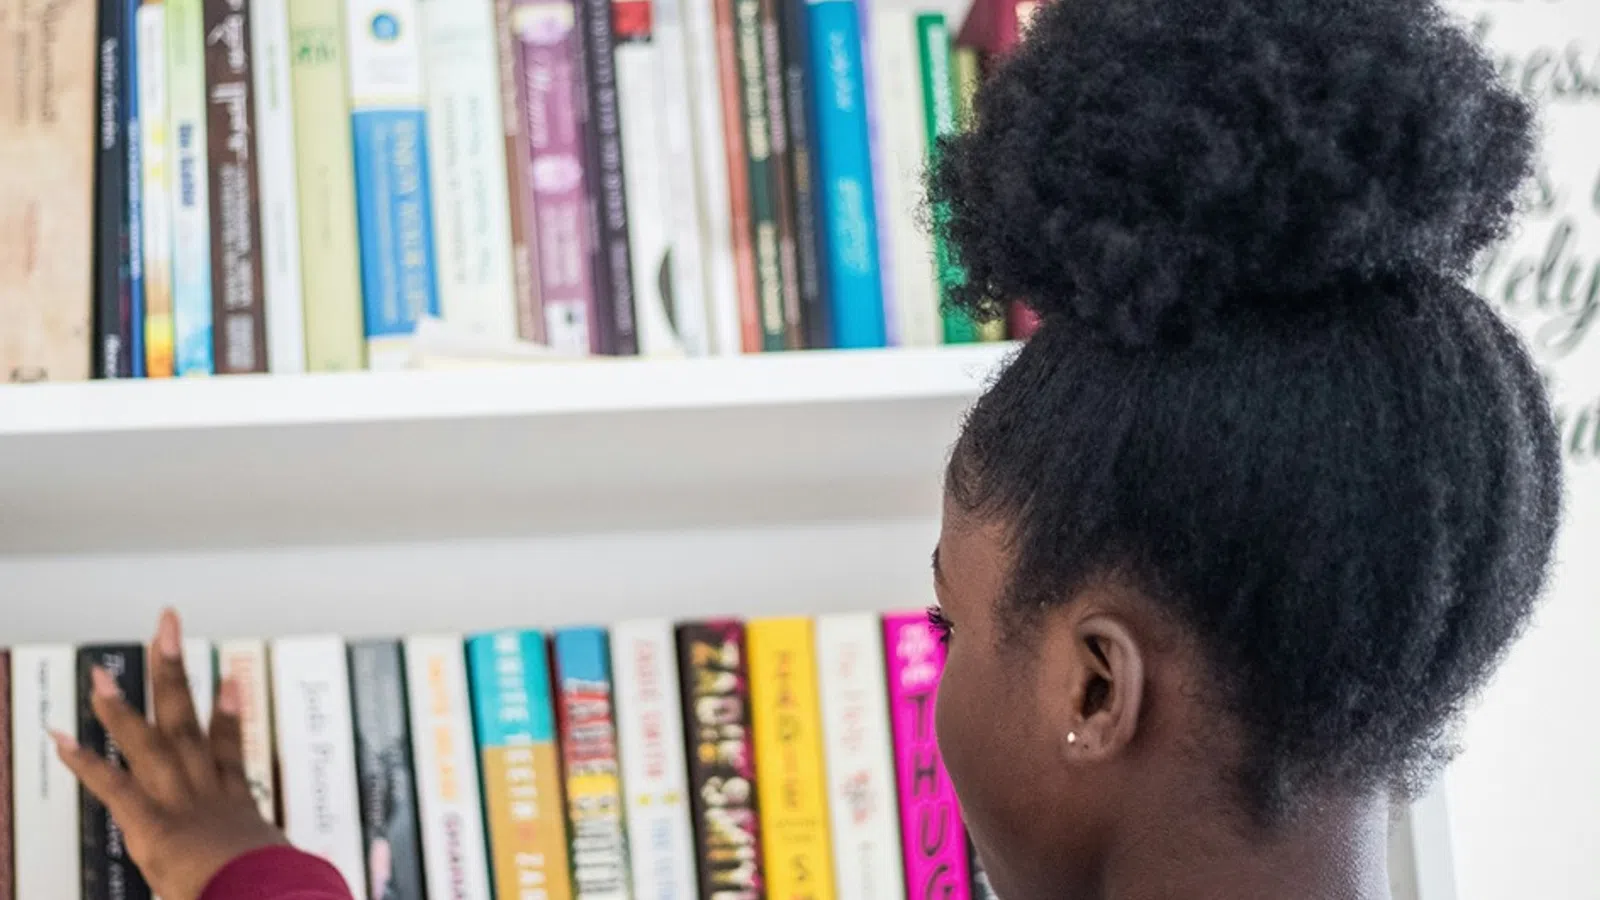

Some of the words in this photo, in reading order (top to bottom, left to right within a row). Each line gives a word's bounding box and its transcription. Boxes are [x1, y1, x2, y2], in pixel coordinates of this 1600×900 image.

[491, 631, 529, 722] WHITE
[691, 639, 746, 768] ZADIE
[560, 678, 617, 776] ZADIE
[504, 731, 541, 821] TEETH
